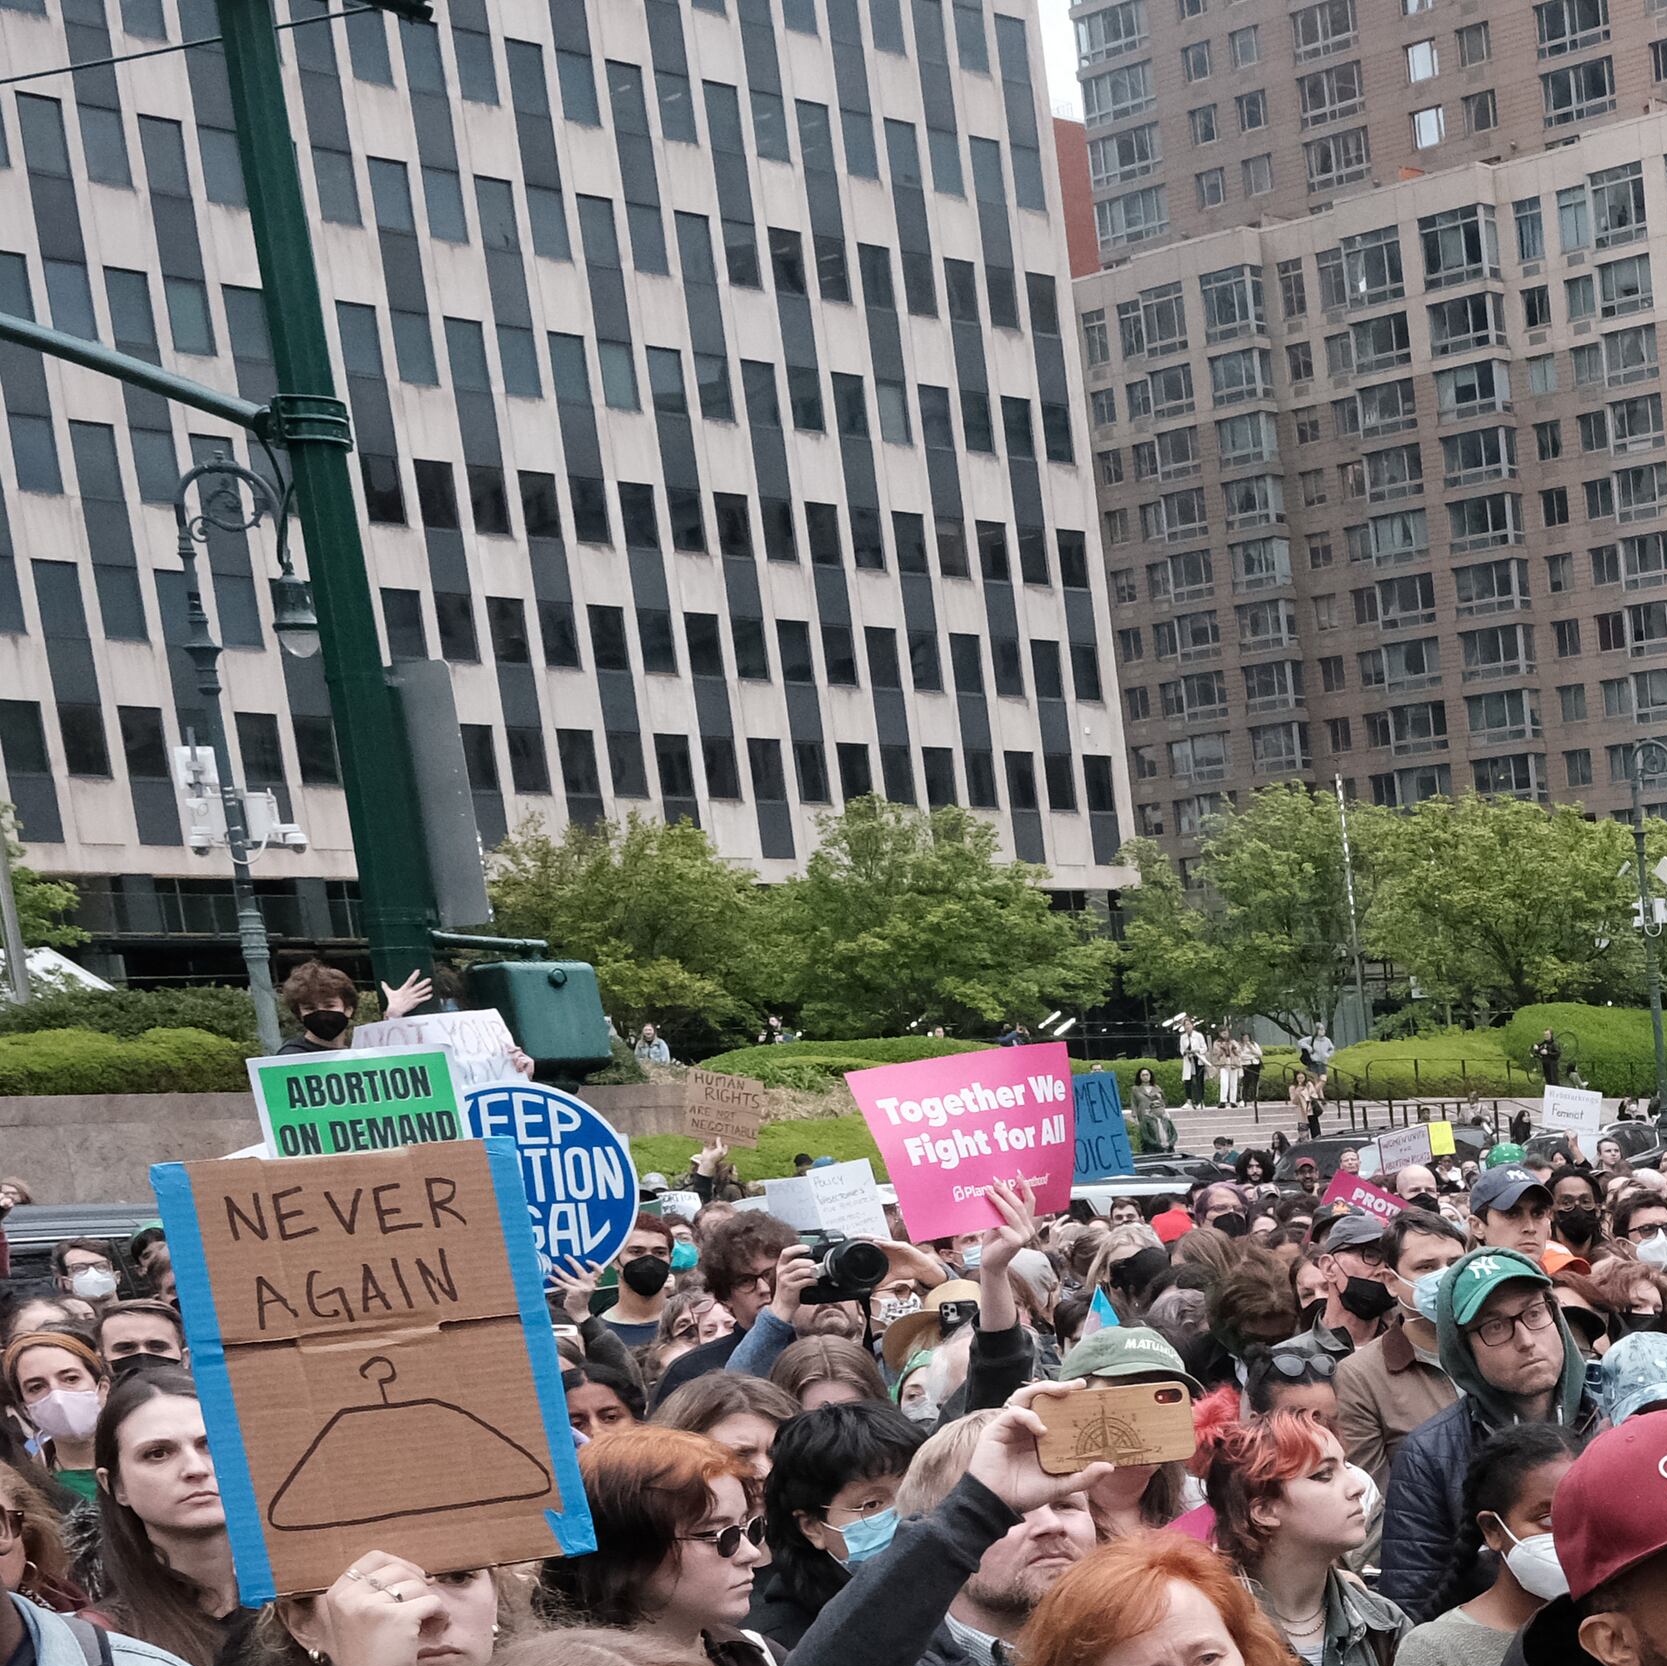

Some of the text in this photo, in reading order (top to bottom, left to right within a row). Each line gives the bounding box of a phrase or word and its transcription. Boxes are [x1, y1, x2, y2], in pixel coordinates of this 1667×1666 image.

[286, 1065, 431, 1110] ABORTION
[694, 1072, 745, 1091] HUMAN
[705, 1086, 760, 1109] RIGHTS
[876, 1074, 1067, 1127] Together We
[279, 1109, 458, 1157] ON DEMAND
[689, 1105, 735, 1119] ARE NOT
[691, 1118, 759, 1139] NEGOTIABLE
[903, 1114, 1067, 1170] Fight for All
[224, 1177, 468, 1241] NEVER
[255, 1247, 460, 1330] AGAIN
